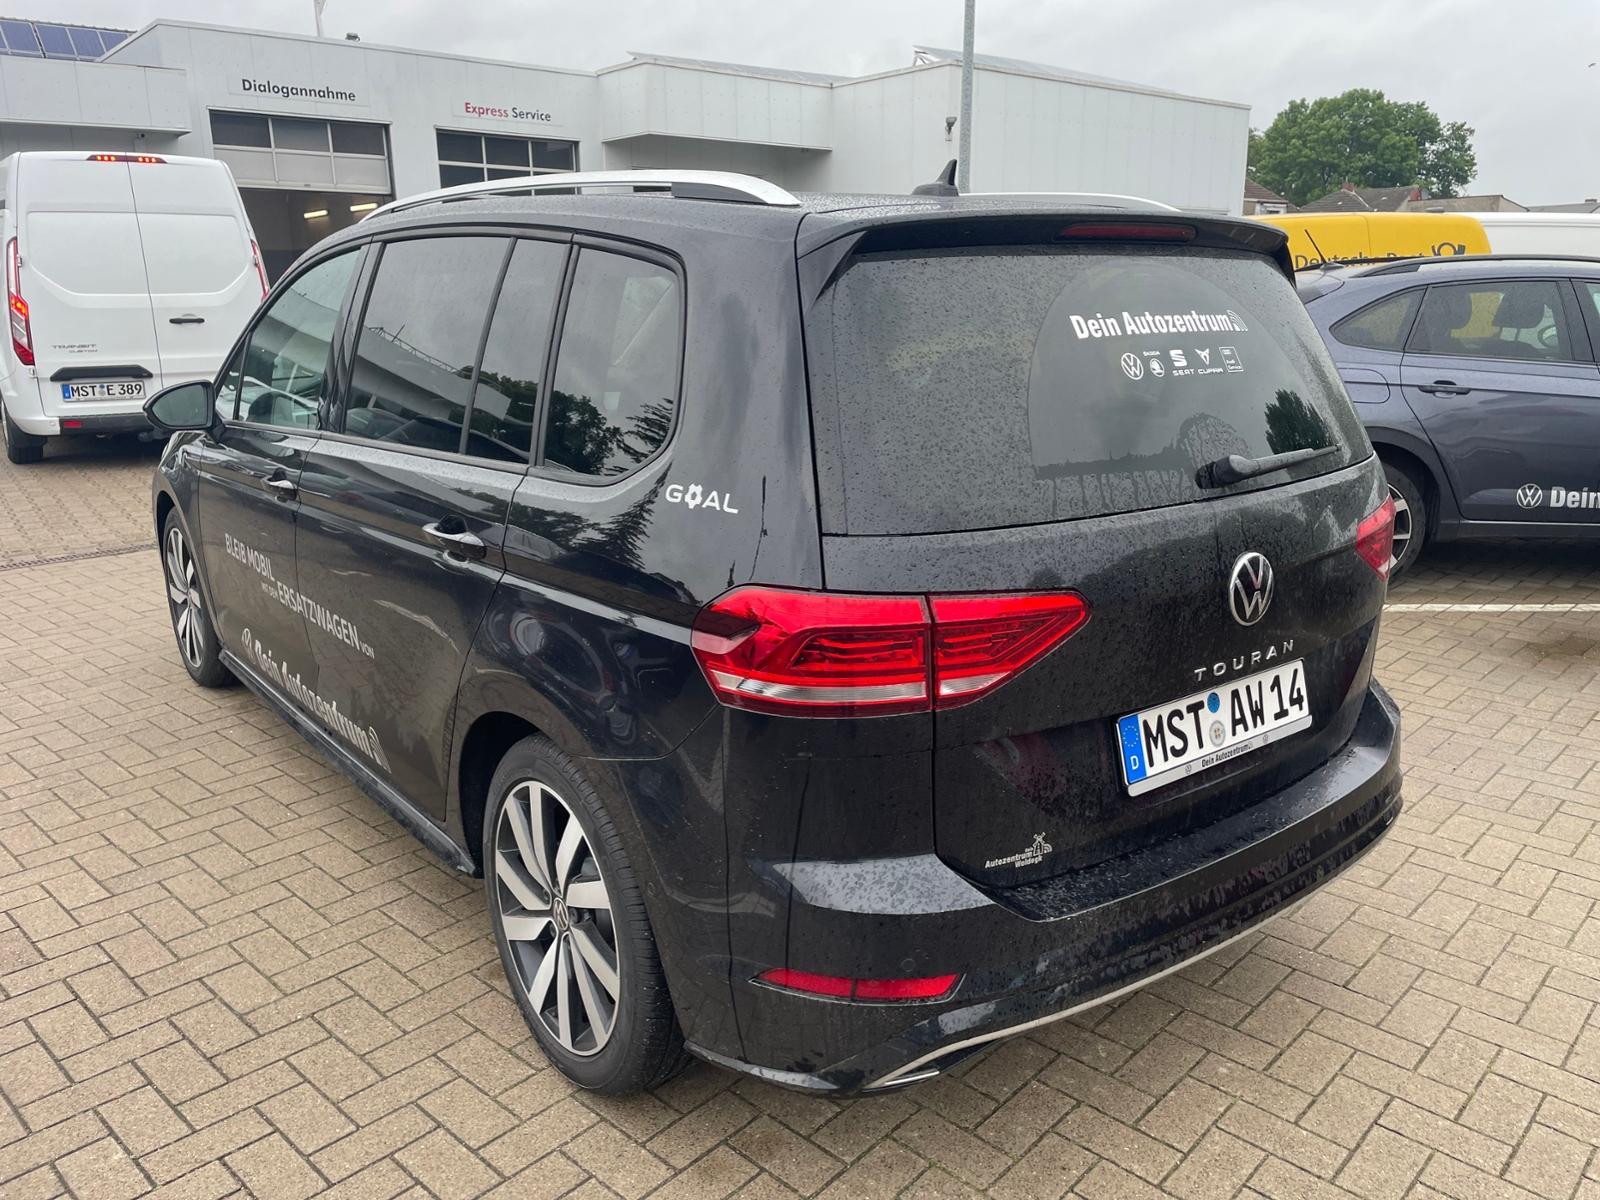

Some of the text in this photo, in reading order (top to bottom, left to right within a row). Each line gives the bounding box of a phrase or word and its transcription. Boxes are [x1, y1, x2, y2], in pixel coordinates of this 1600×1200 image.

[242, 79, 356, 101] Dialogannahme
[464, 102, 551, 121] Express Service
[1070, 310, 1233, 339] Dein Autozentrum
[1172, 369, 1195, 377] SEAT
[70, 383, 142, 398] MST E 389
[1550, 486, 1600, 509] Dein
[225, 533, 275, 582] BLEIB MOBIL
[277, 581, 360, 650] ERSATZWAGEN
[359, 640, 375, 659] VON
[1194, 639, 1295, 682] TOURAN
[255, 639, 374, 760] Dein Autozentrum
[1130, 668, 1304, 770] D MST AW 14
[1201, 744, 1249, 768] Dein Autozentrum
[984, 851, 1033, 869] Autozentrum
